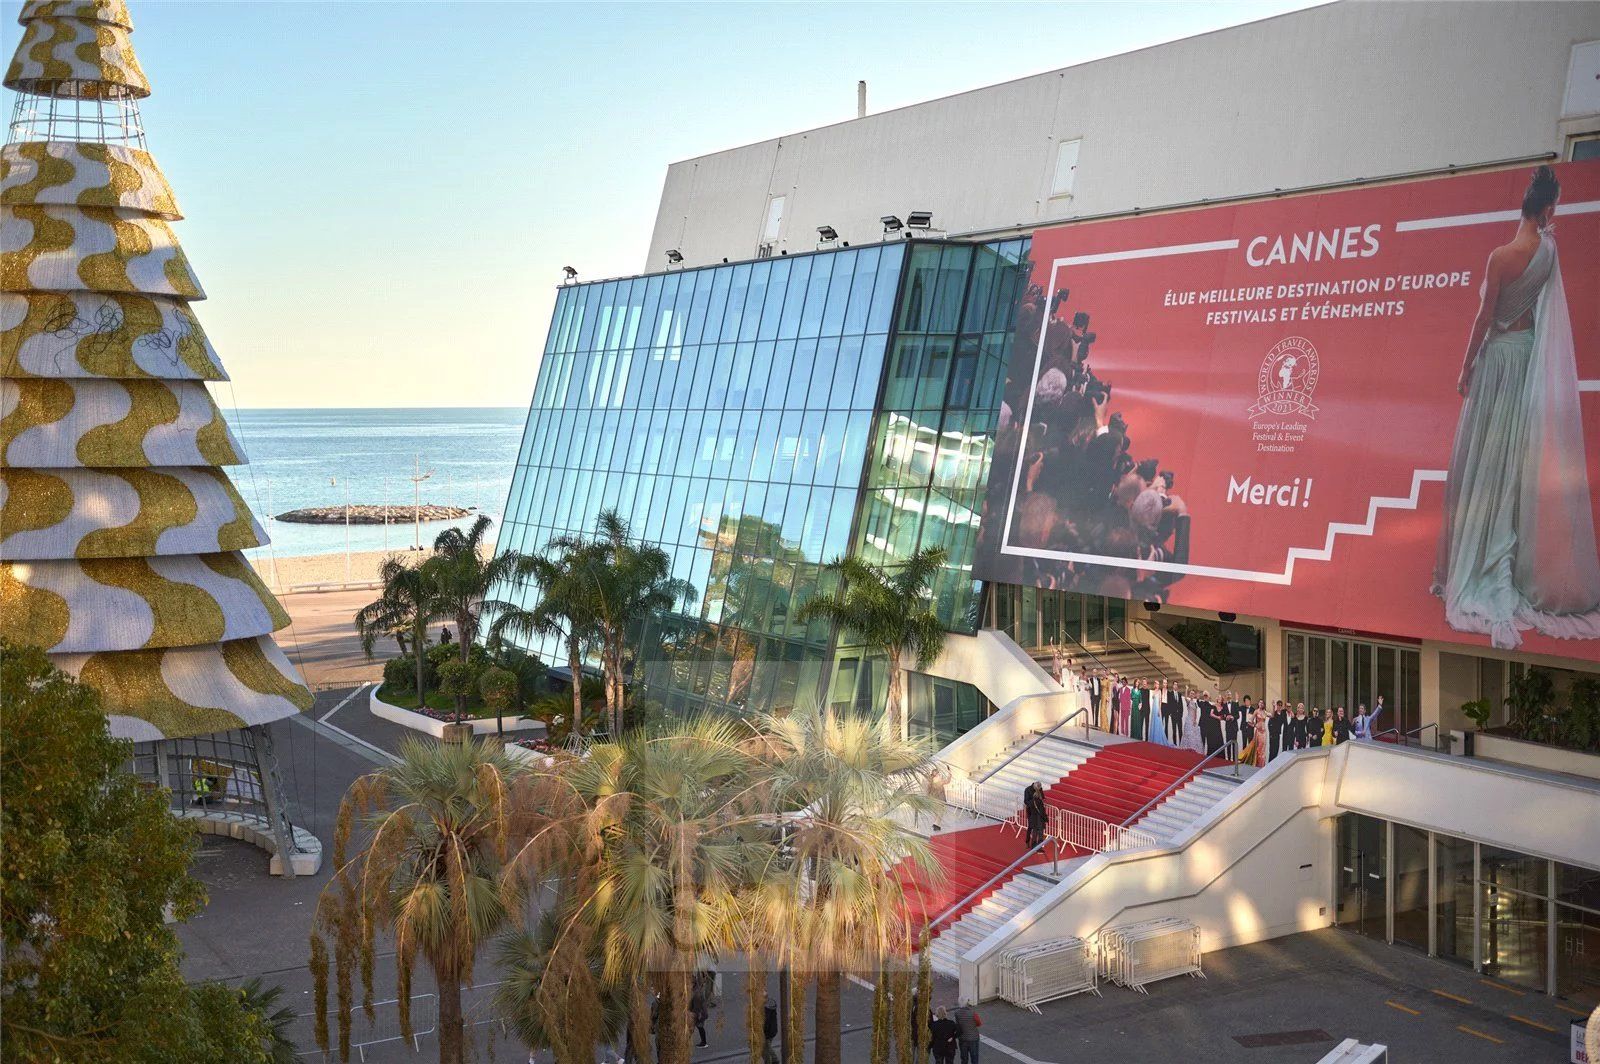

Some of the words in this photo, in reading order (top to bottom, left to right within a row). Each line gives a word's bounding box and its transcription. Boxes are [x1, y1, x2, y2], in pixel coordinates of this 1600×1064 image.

[1246, 223, 1381, 268] CANNES
[1164, 289, 1196, 306] ÉLUE
[1198, 285, 1274, 304] MEILLEURE
[1277, 278, 1380, 299] DESTINATION
[1384, 271, 1471, 292] D'EUROPE
[1206, 308, 1277, 325] FESTIVALS
[1280, 307, 1298, 321] ET
[1301, 300, 1405, 320] ÉVÉNEMENTS
[1276, 339, 1306, 353] TRAVEL
[1305, 347, 1319, 391] AWARDS
[1263, 392, 1306, 404] WINNER
[1272, 402, 1293, 413] 2021
[1253, 421, 1280, 432] Europe's
[1281, 421, 1308, 433] Leading
[1252, 432, 1277, 441] Festival
[1277, 432, 1284, 441] &
[1285, 432, 1304, 442] Event
[1257, 443, 1295, 453] Destination
